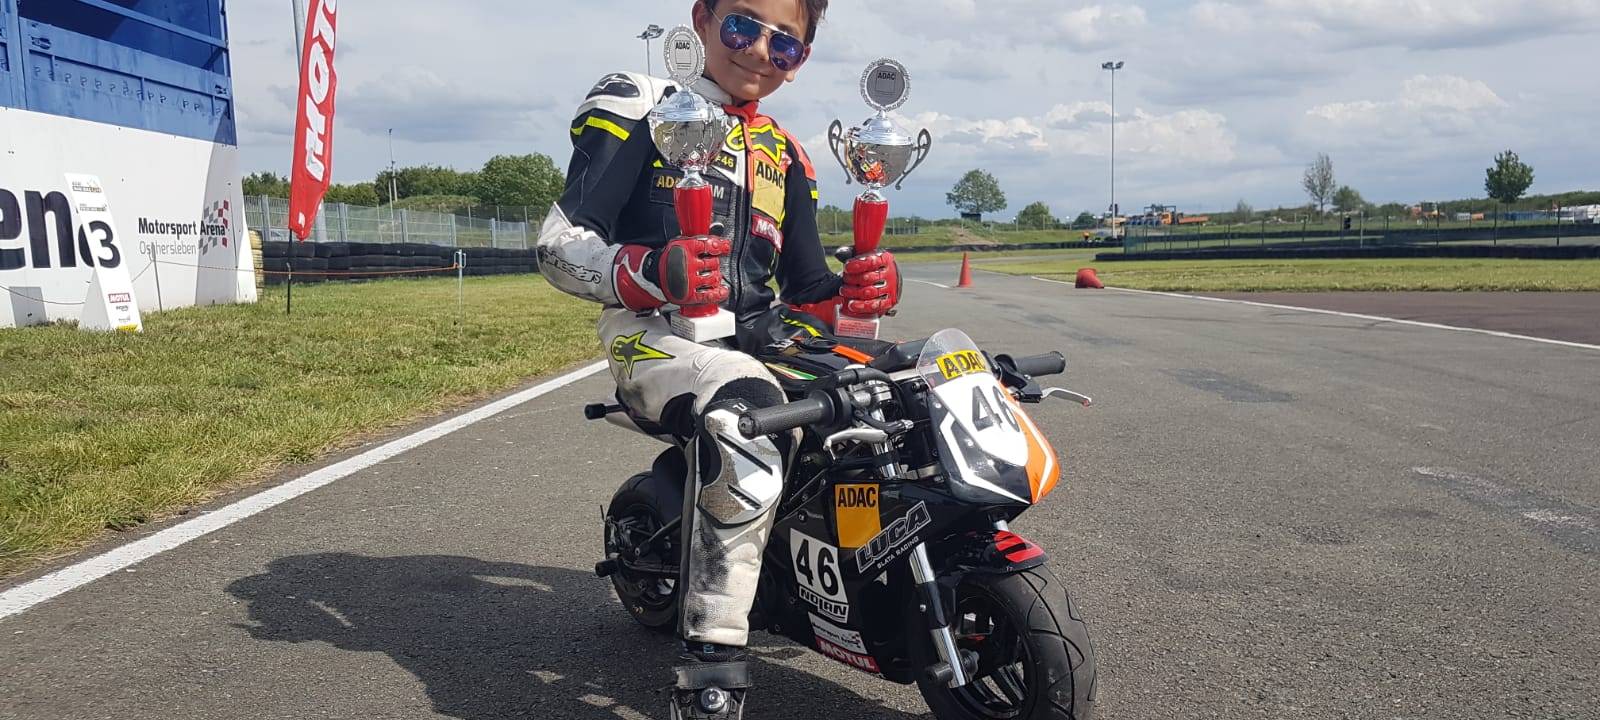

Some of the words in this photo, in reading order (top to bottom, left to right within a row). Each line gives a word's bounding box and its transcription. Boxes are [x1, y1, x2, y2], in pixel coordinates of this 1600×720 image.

[675, 42, 690, 50] ADAC
[304, 0, 337, 182] MOT
[877, 72, 896, 80] ADAC
[755, 161, 784, 190] ADAC
[138, 217, 197, 240] Motorsport
[200, 220, 226, 236] Arena
[88, 220, 121, 268] 3
[972, 385, 1020, 432] 46
[837, 487, 876, 508] ADAC
[856, 500, 932, 574] LUCA
[895, 535, 920, 556] RACING
[796, 538, 839, 596] 46
[800, 586, 848, 617] NOLAN
[818, 640, 876, 670] MOTUL
